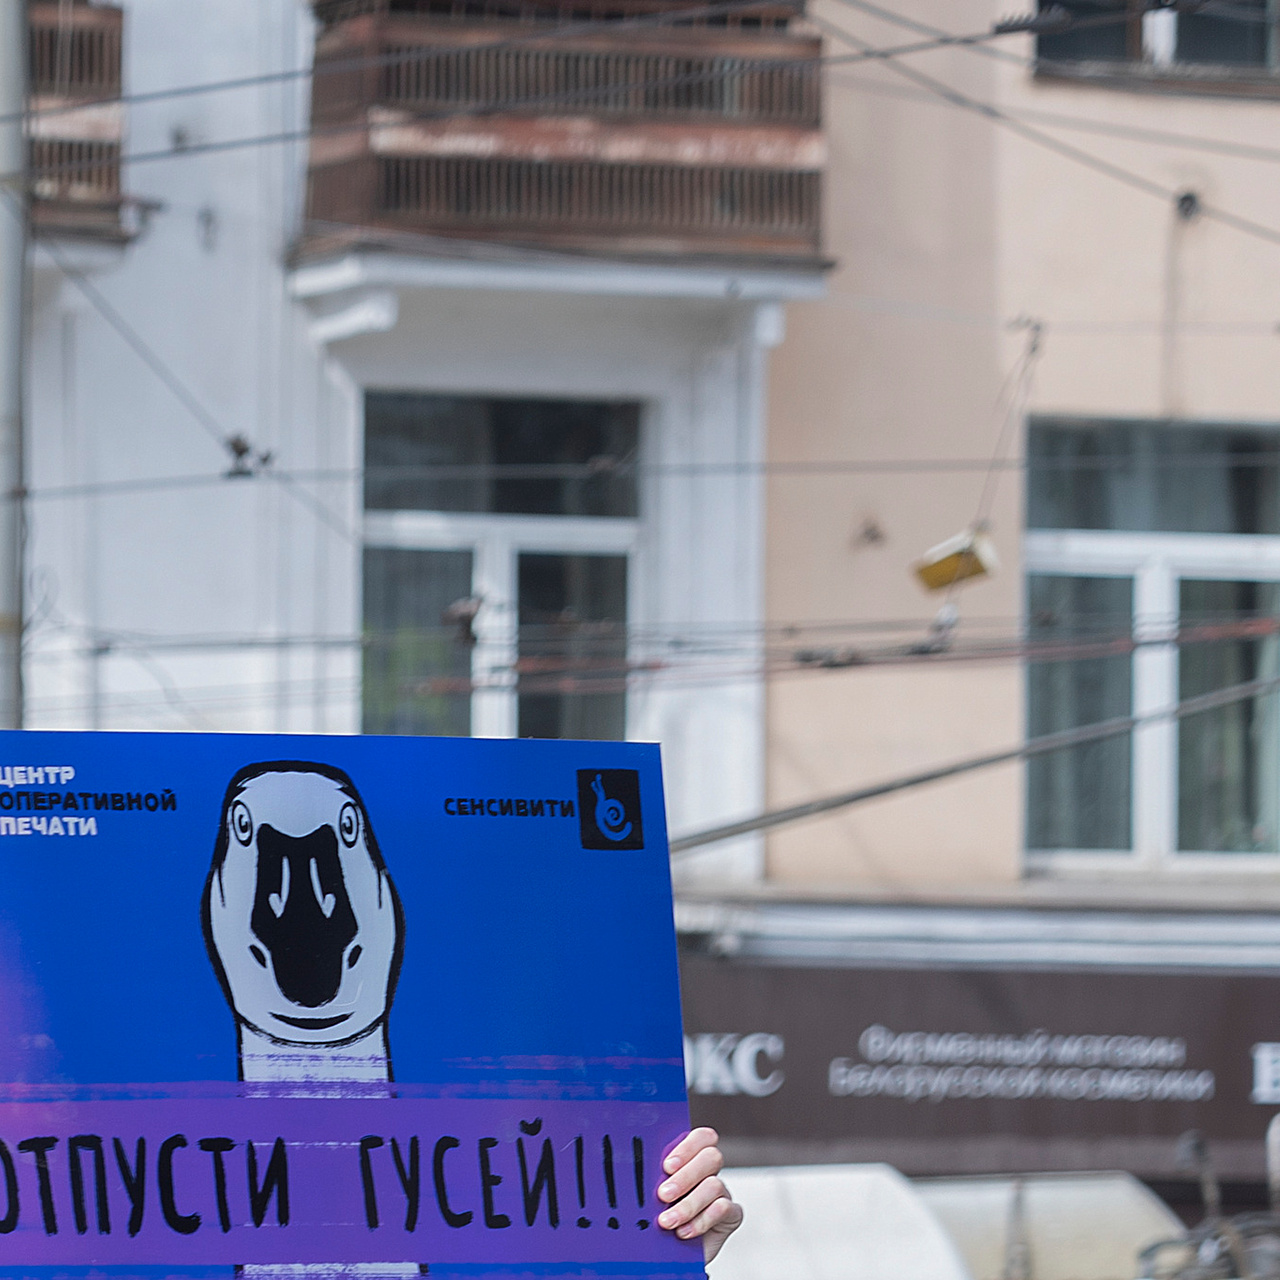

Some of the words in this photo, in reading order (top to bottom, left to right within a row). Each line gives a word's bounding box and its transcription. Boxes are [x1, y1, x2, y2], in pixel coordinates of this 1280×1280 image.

[0, 816, 99, 836] ПЕЧАТИ
[444, 798, 576, 818] СЕНСИВИТИ
[684, 1032, 785, 1097] КС
[360, 1116, 650, 1232] ГУСЕЙ!!!
